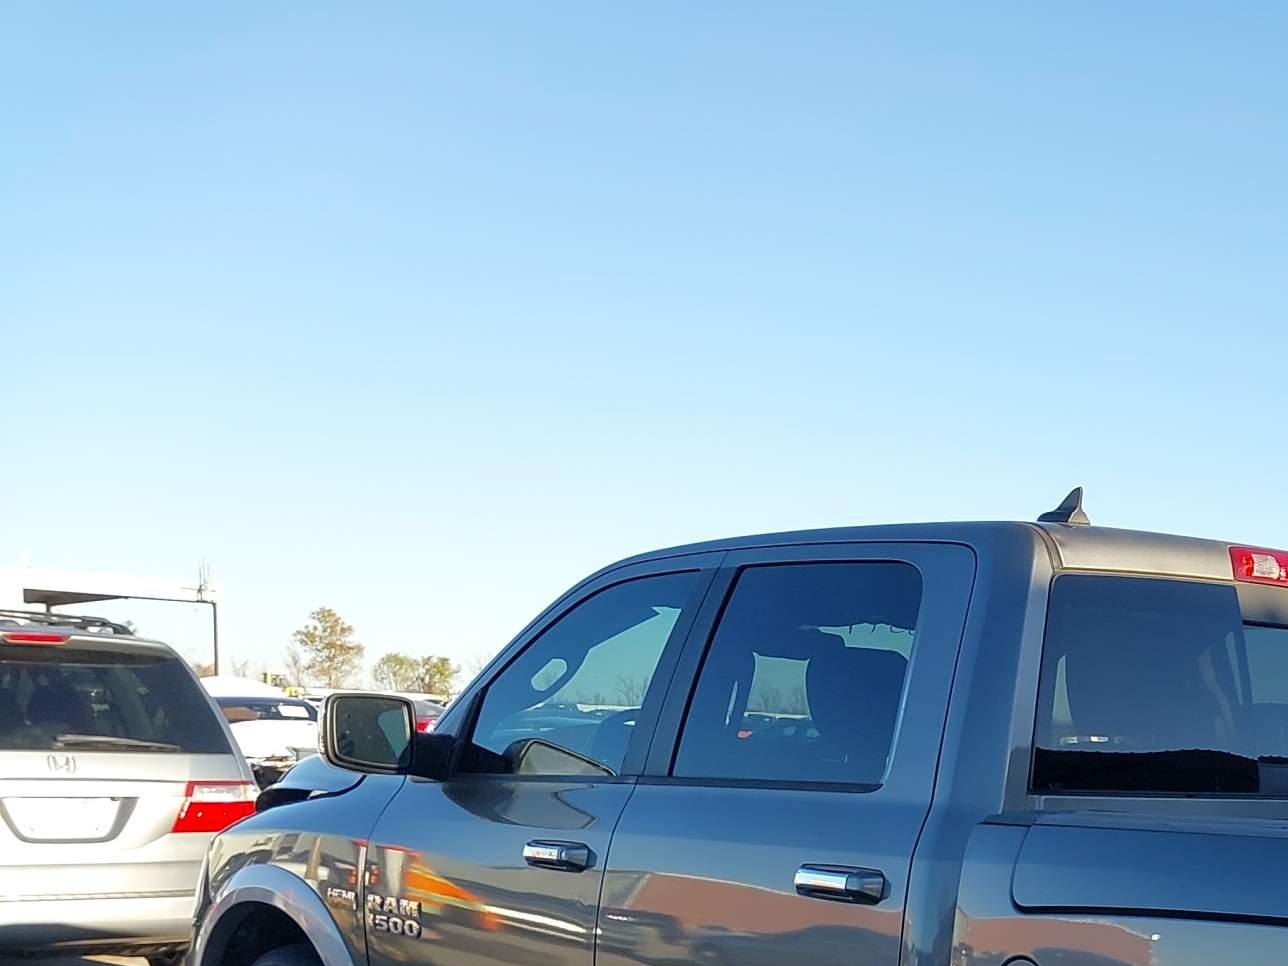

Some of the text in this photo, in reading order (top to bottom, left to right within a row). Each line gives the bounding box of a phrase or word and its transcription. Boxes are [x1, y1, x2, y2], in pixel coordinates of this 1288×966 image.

[327, 887, 355, 901] HEMI
[367, 893, 420, 917] RAM
[368, 914, 420, 936] 1500
